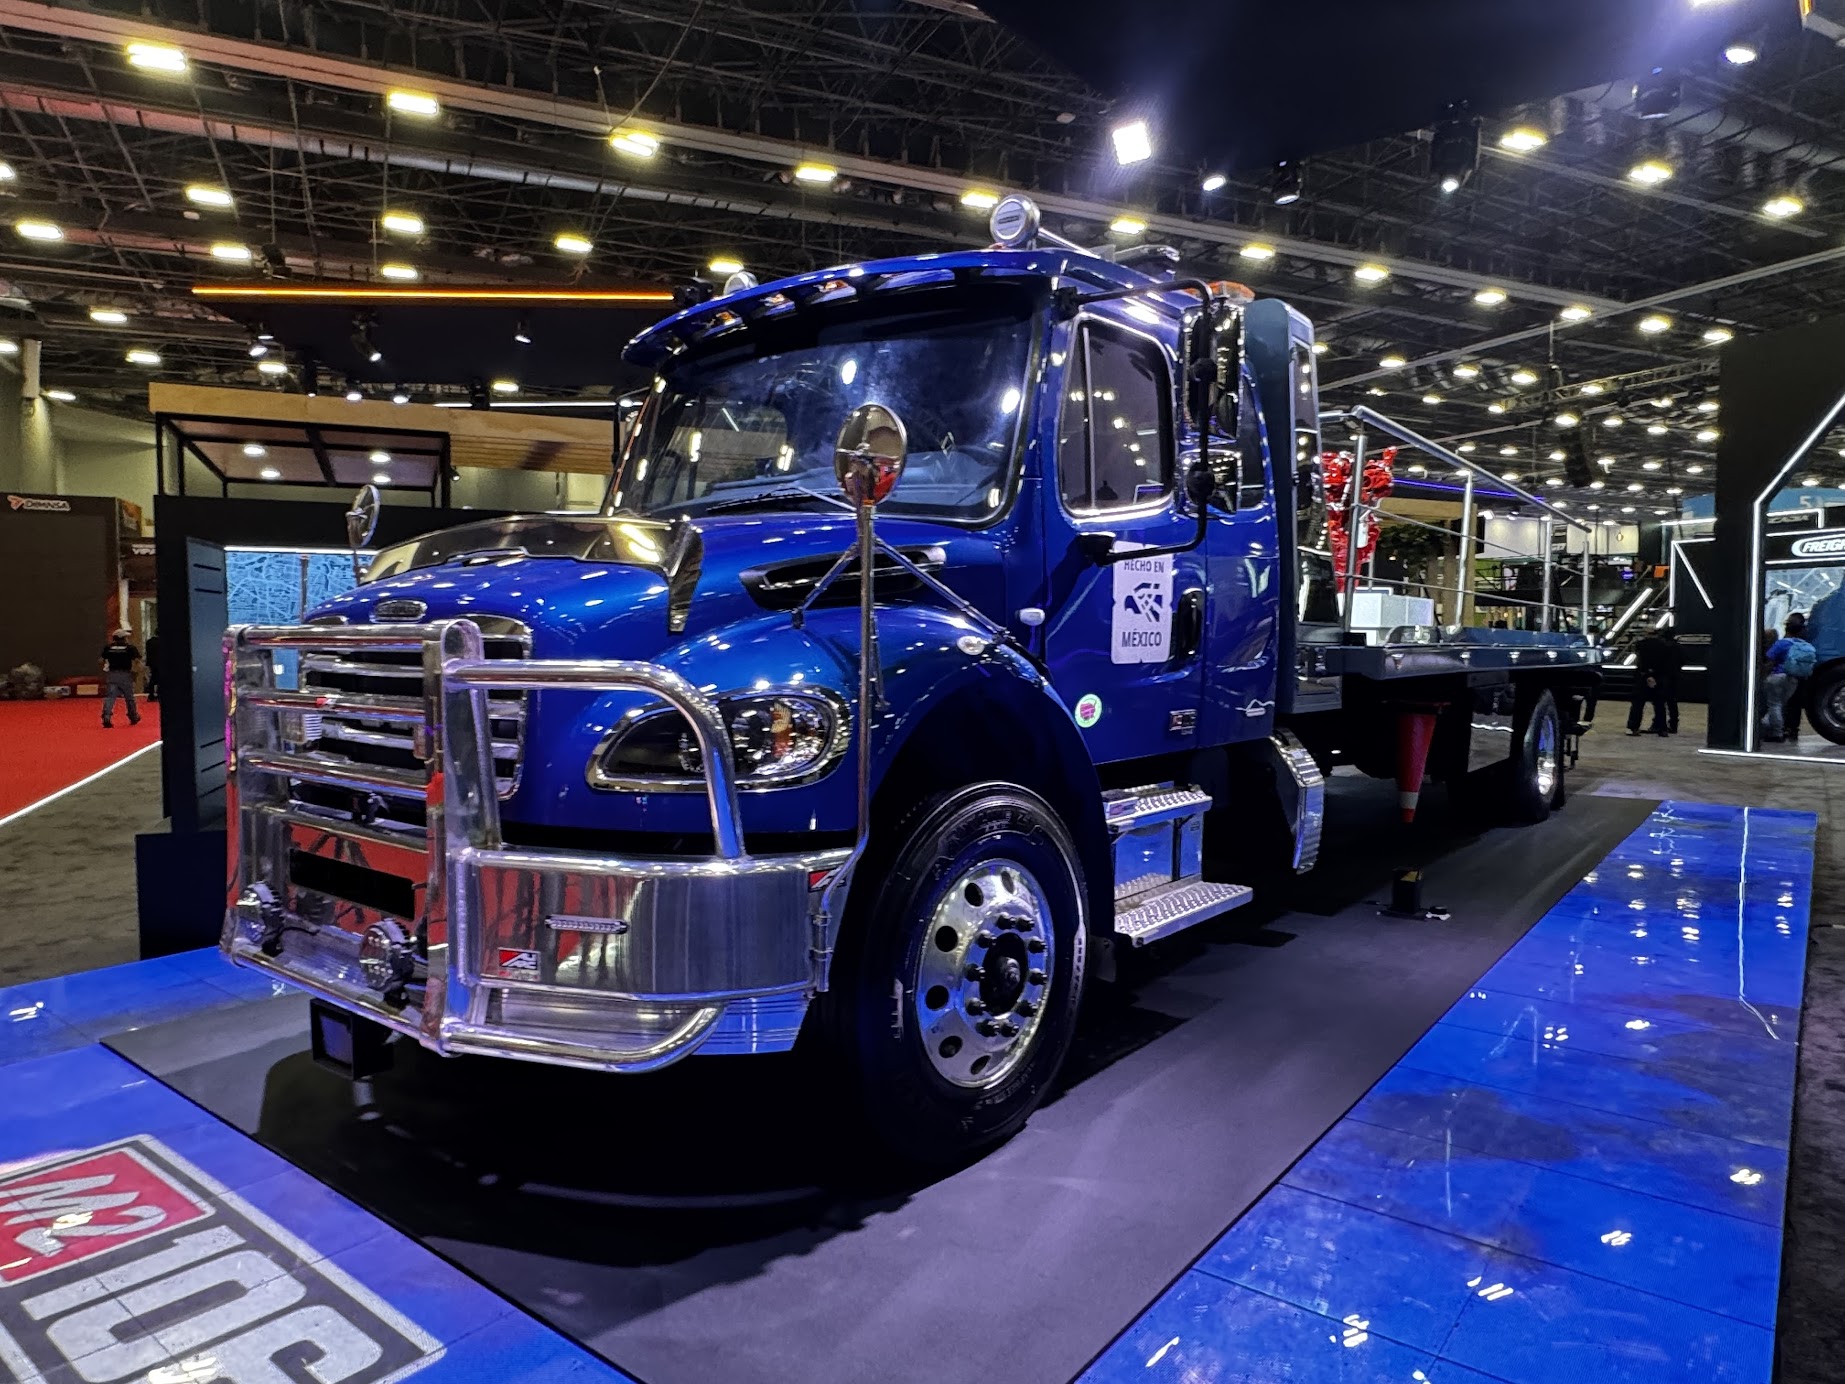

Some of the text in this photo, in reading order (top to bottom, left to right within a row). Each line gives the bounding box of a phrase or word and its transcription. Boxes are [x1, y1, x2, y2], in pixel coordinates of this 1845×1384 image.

[1124, 560, 1164, 573] HECHO EN
[1122, 628, 1162, 648] MÉXICO
